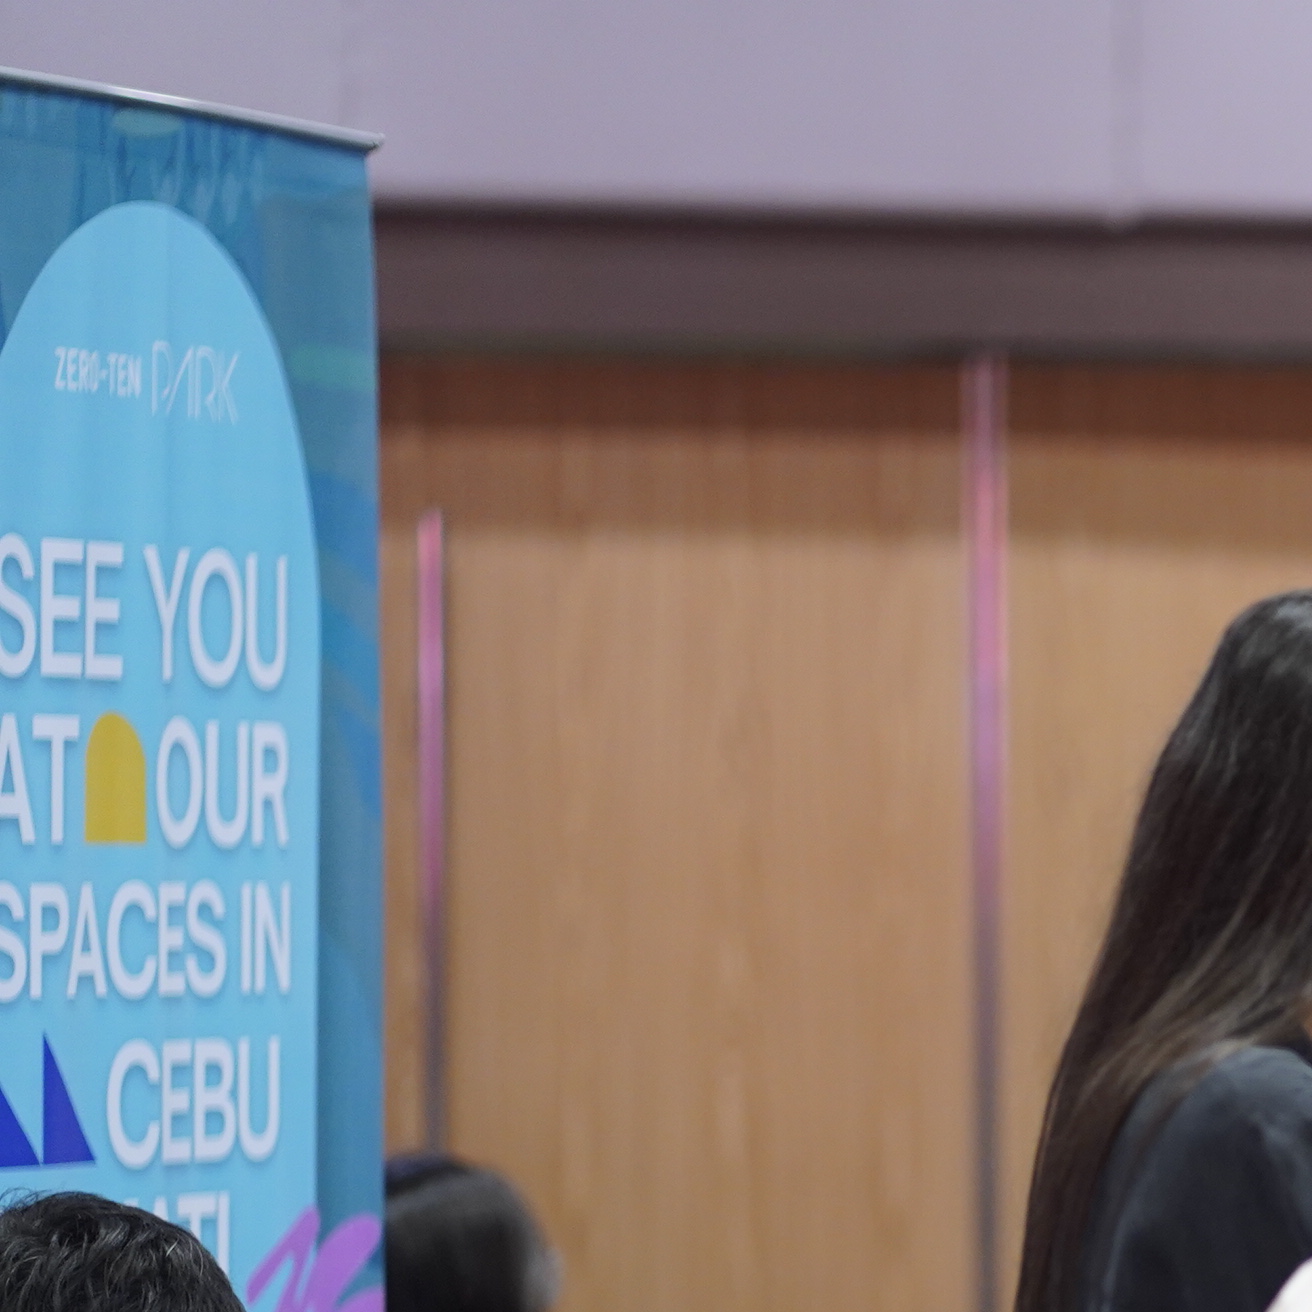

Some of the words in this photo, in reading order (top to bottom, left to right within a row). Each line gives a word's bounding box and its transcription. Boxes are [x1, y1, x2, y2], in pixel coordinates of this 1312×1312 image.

[0, 531, 124, 682] SEE
[143, 542, 289, 690] YOU
[0, 711, 80, 846] AT
[155, 714, 290, 851] OUR
[0, 878, 227, 999] SPACES
[240, 879, 292, 995] IN
[106, 1035, 281, 1169] CEBU
